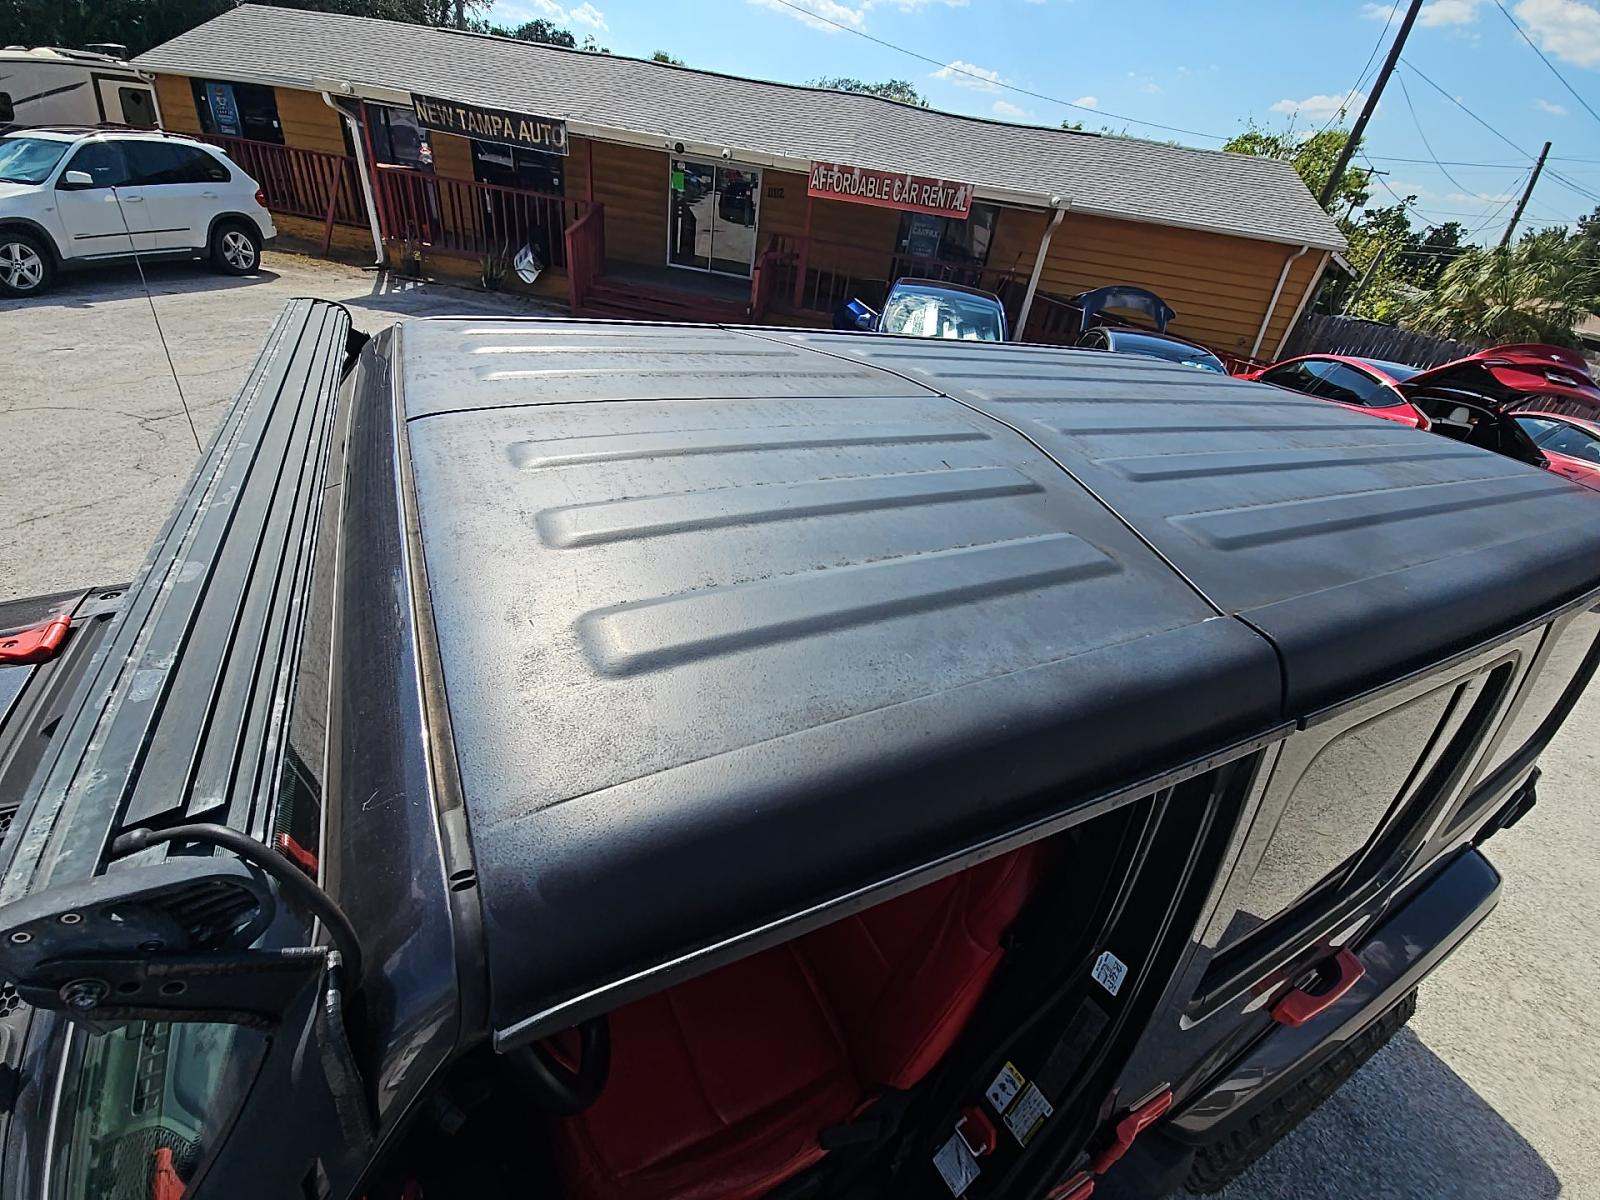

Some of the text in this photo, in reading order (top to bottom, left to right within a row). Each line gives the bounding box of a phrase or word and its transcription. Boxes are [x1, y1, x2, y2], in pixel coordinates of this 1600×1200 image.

[415, 101, 566, 147] NEW TAMPA AUTO
[811, 168, 967, 212] AFFORDABLE CAR RENTAL
